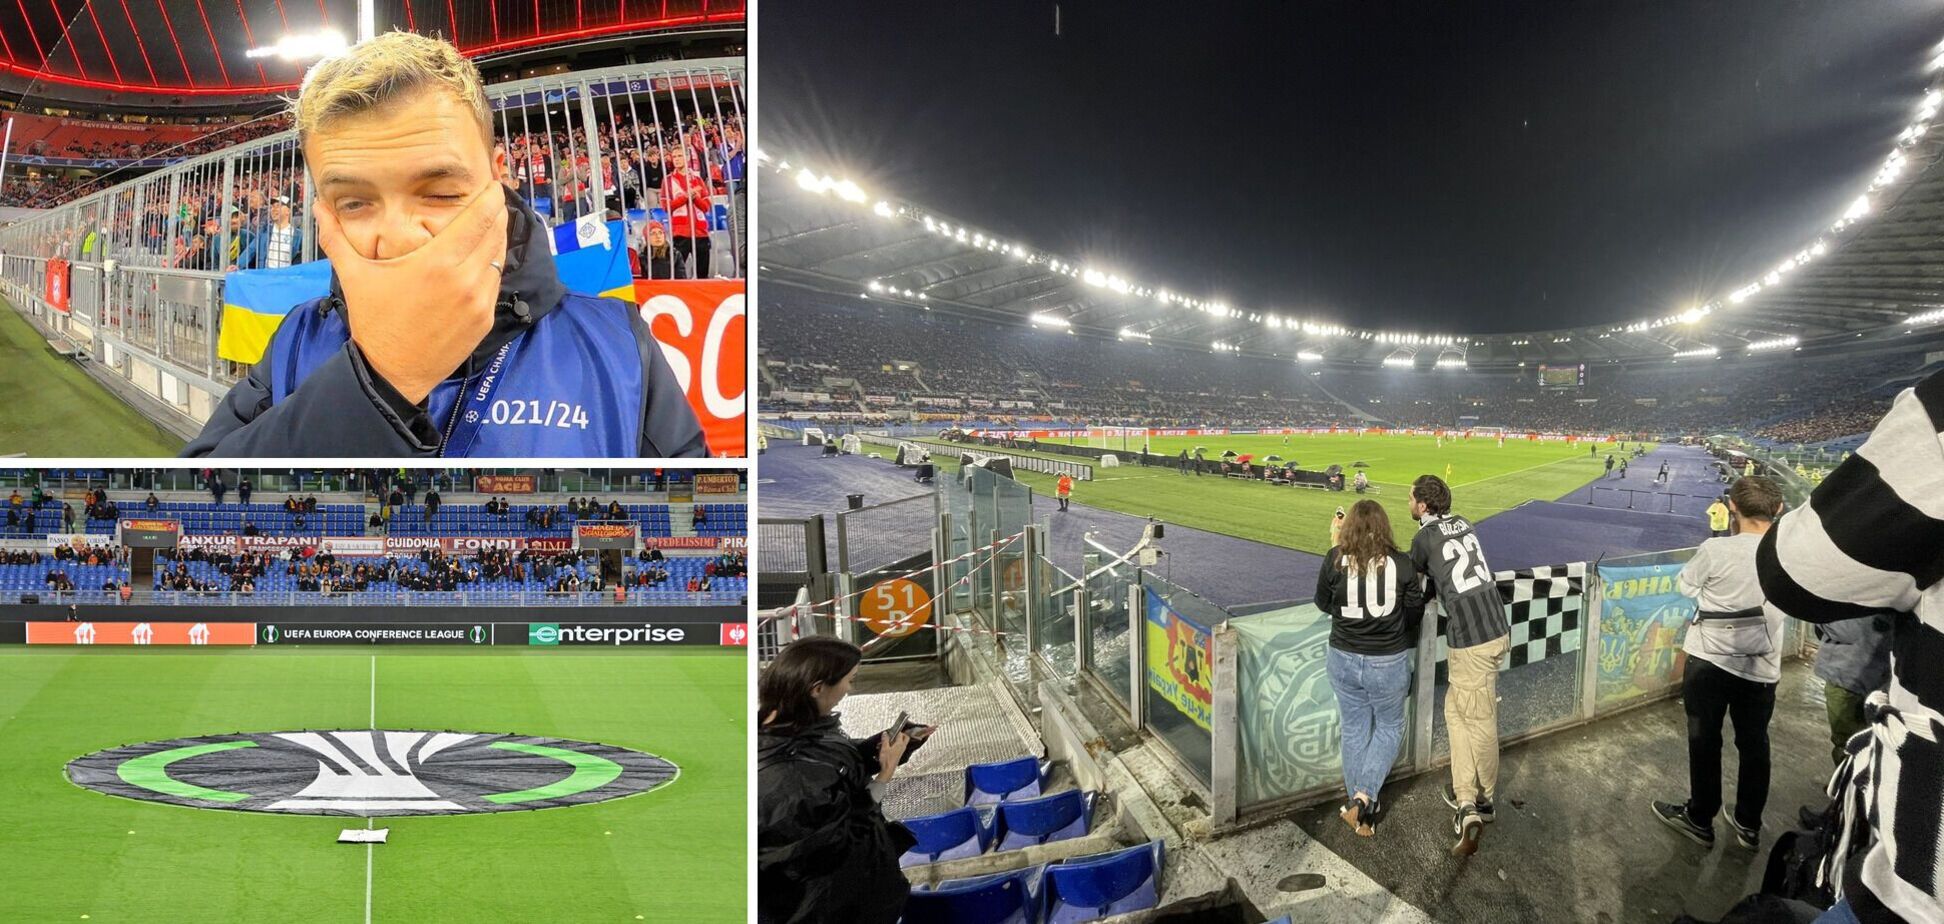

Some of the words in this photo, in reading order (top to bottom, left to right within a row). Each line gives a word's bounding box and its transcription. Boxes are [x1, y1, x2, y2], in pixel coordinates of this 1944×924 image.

[476, 375, 496, 402] UEFA
[481, 400, 589, 430] 021/24
[493, 482, 531, 492] ACEA
[49, 536, 69, 544] PASSO
[180, 536, 236, 545] ANXUR
[241, 536, 317, 545] TRAPANI
[386, 538, 441, 548] GUIDONIA
[453, 539, 516, 550] FONDI
[657, 537, 715, 547] FEDELISSIMI
[1442, 533, 1492, 594] 23
[1340, 553, 1398, 619] 10
[877, 583, 914, 610] 51
[284, 629, 312, 639] UEFA
[313, 629, 353, 639] EUROPA
[354, 629, 422, 639] CONFERENCE
[425, 629, 465, 639] LEAGUE
[536, 624, 685, 645] enterprise
